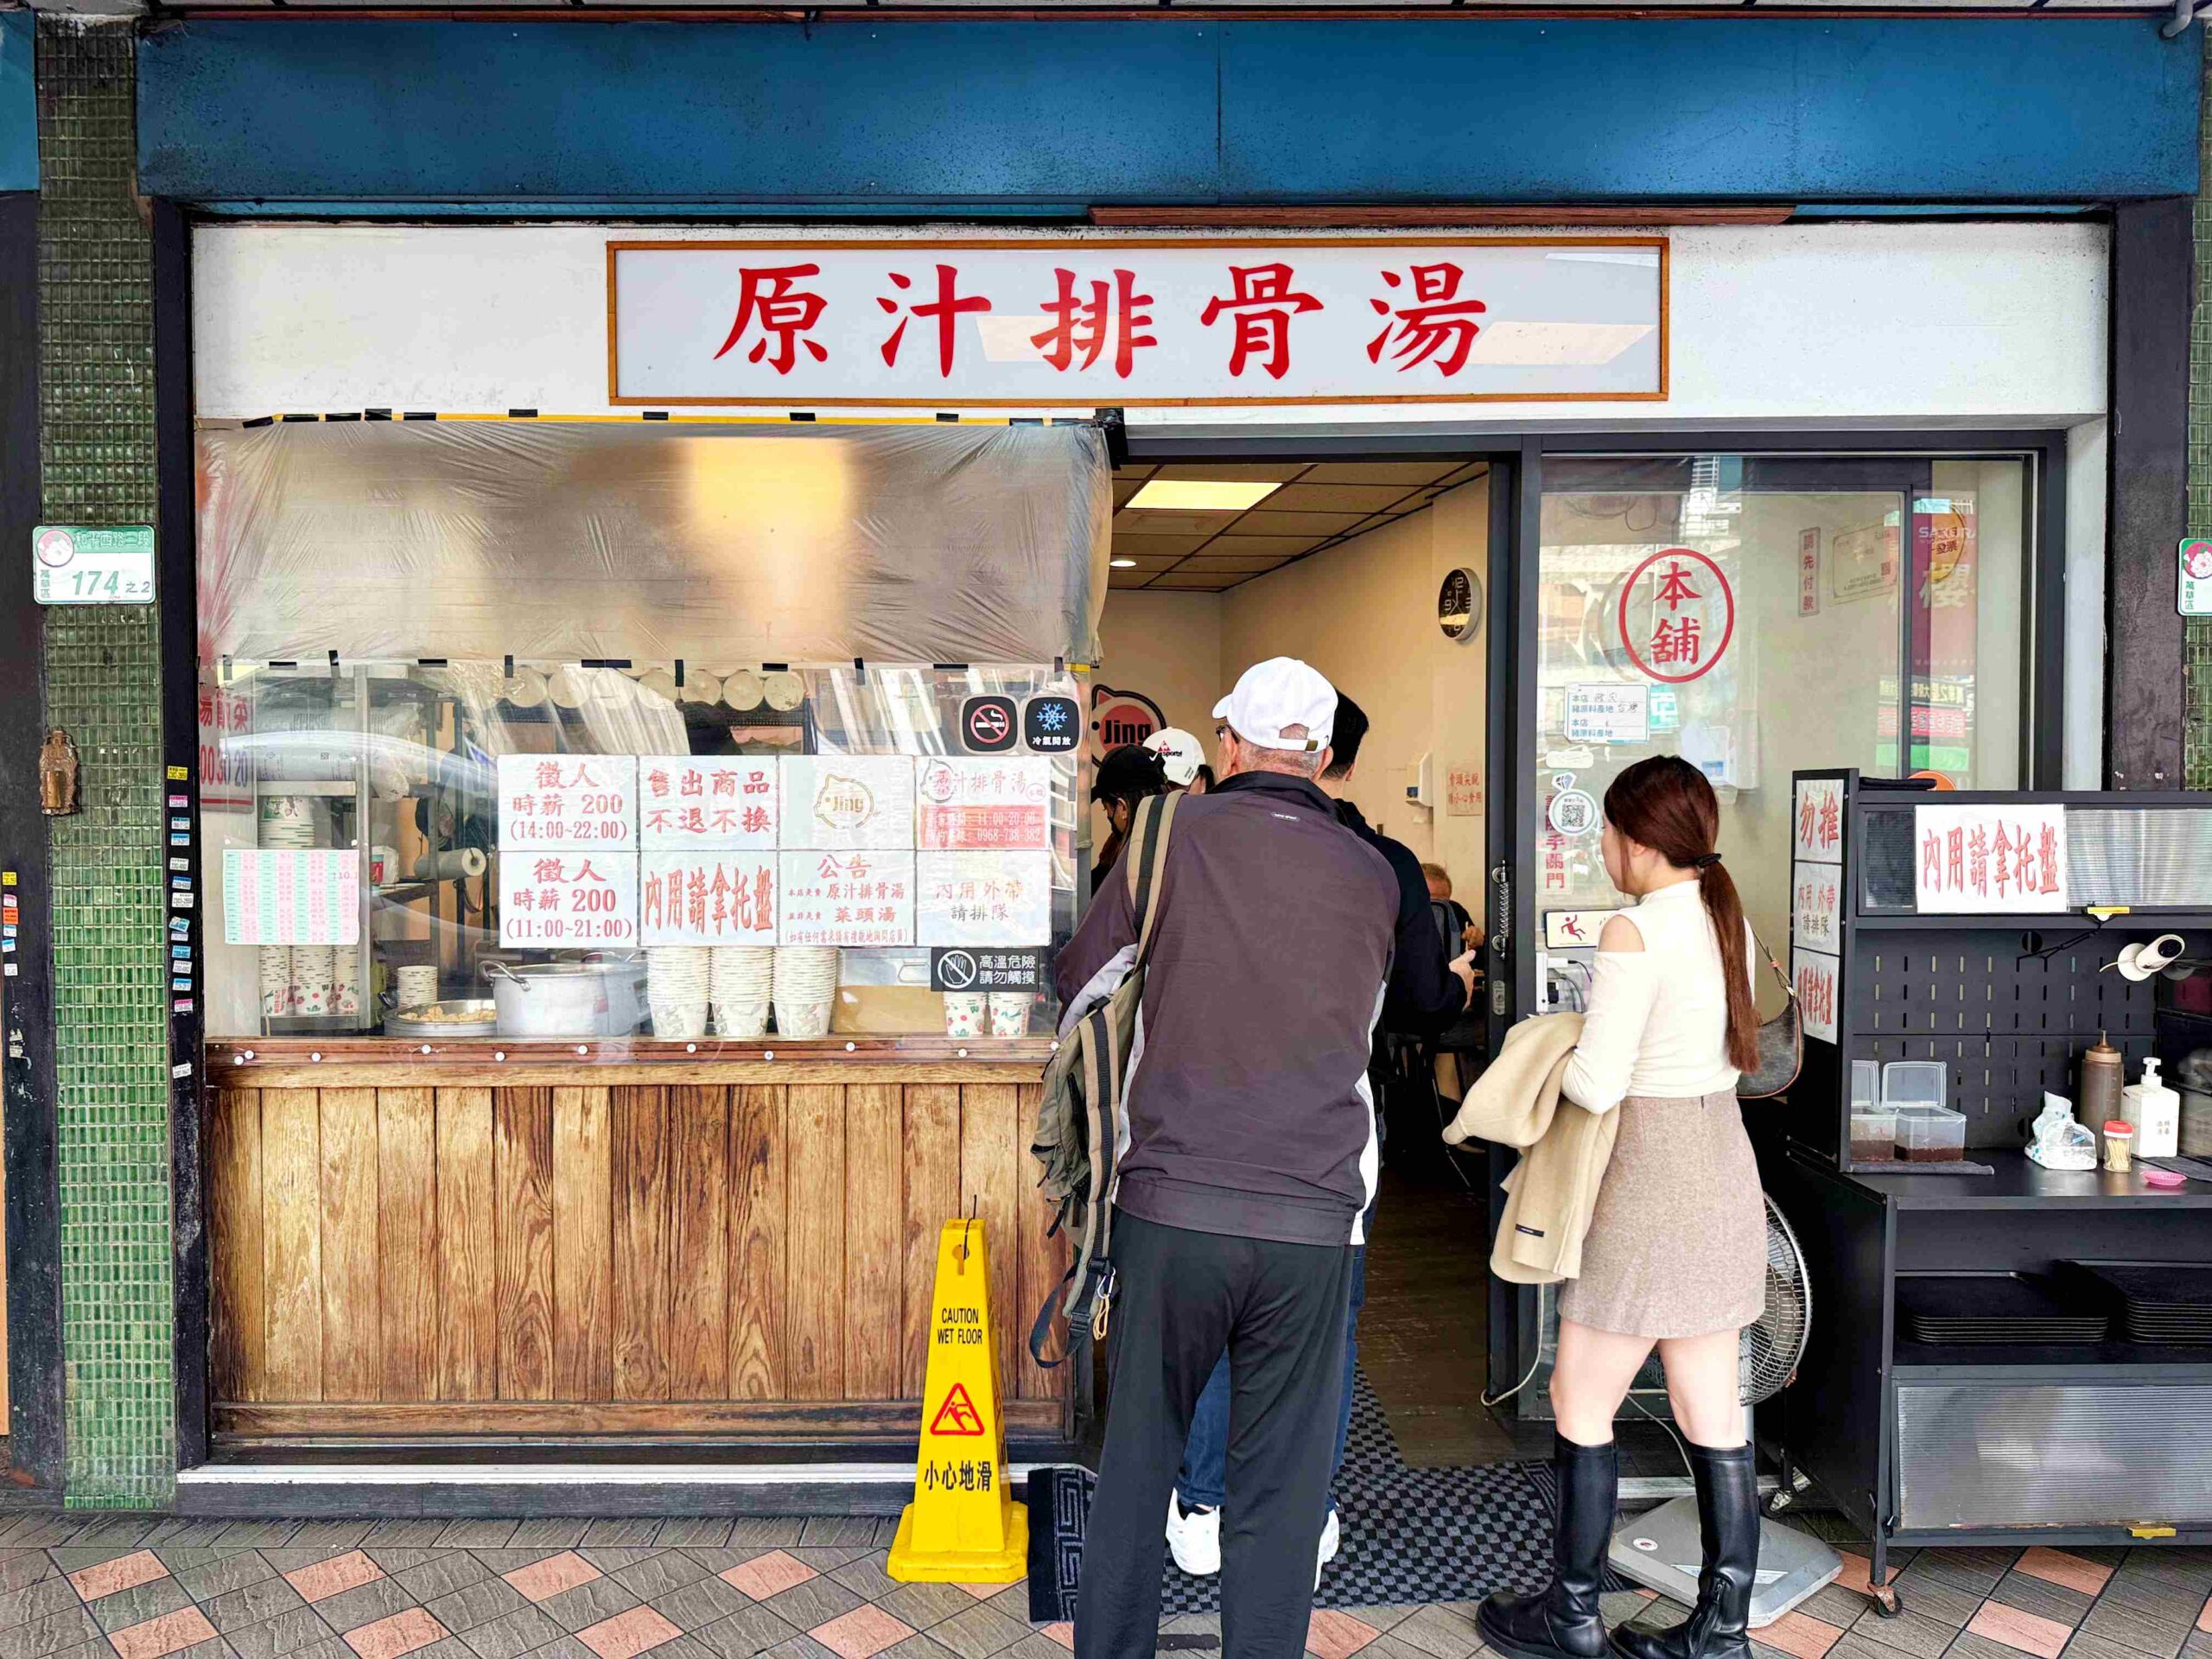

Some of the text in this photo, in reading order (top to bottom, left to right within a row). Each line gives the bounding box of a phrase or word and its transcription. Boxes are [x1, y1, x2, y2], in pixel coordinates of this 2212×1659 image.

[713, 261, 1487, 380] 原汁排骨湯
[1649, 561, 1703, 665] 本舖
[1032, 735, 1071, 746] 冷氣開放
[1103, 719, 1151, 747] Jing
[536, 761, 600, 790] 徵人
[646, 769, 770, 798] 售出商品
[512, 793, 623, 817] 時薪 200
[510, 820, 628, 842] (14:00~22:00)
[645, 807, 772, 834] 不退不換
[1799, 790, 1840, 850] 勿推
[533, 856, 607, 884] 徵人
[817, 854, 872, 880] 公告
[1923, 818, 2060, 899] 內用請拿托盤
[512, 888, 617, 913] 時薪 200
[645, 862, 773, 937] 內用請拿托盤
[826, 881, 906, 900] 原汁排骨湯
[835, 906, 897, 924] 菜頭湯
[950, 903, 1010, 922] 請排隊
[506, 918, 632, 940] (11:00~21:00)
[979, 955, 1036, 969] 高溫危險
[979, 970, 1036, 985] 請勿觸摸
[941, 1307, 979, 1325] CAUTION
[938, 1328, 983, 1345] WET FLOOR
[924, 1460, 993, 1493] 小心地滑
